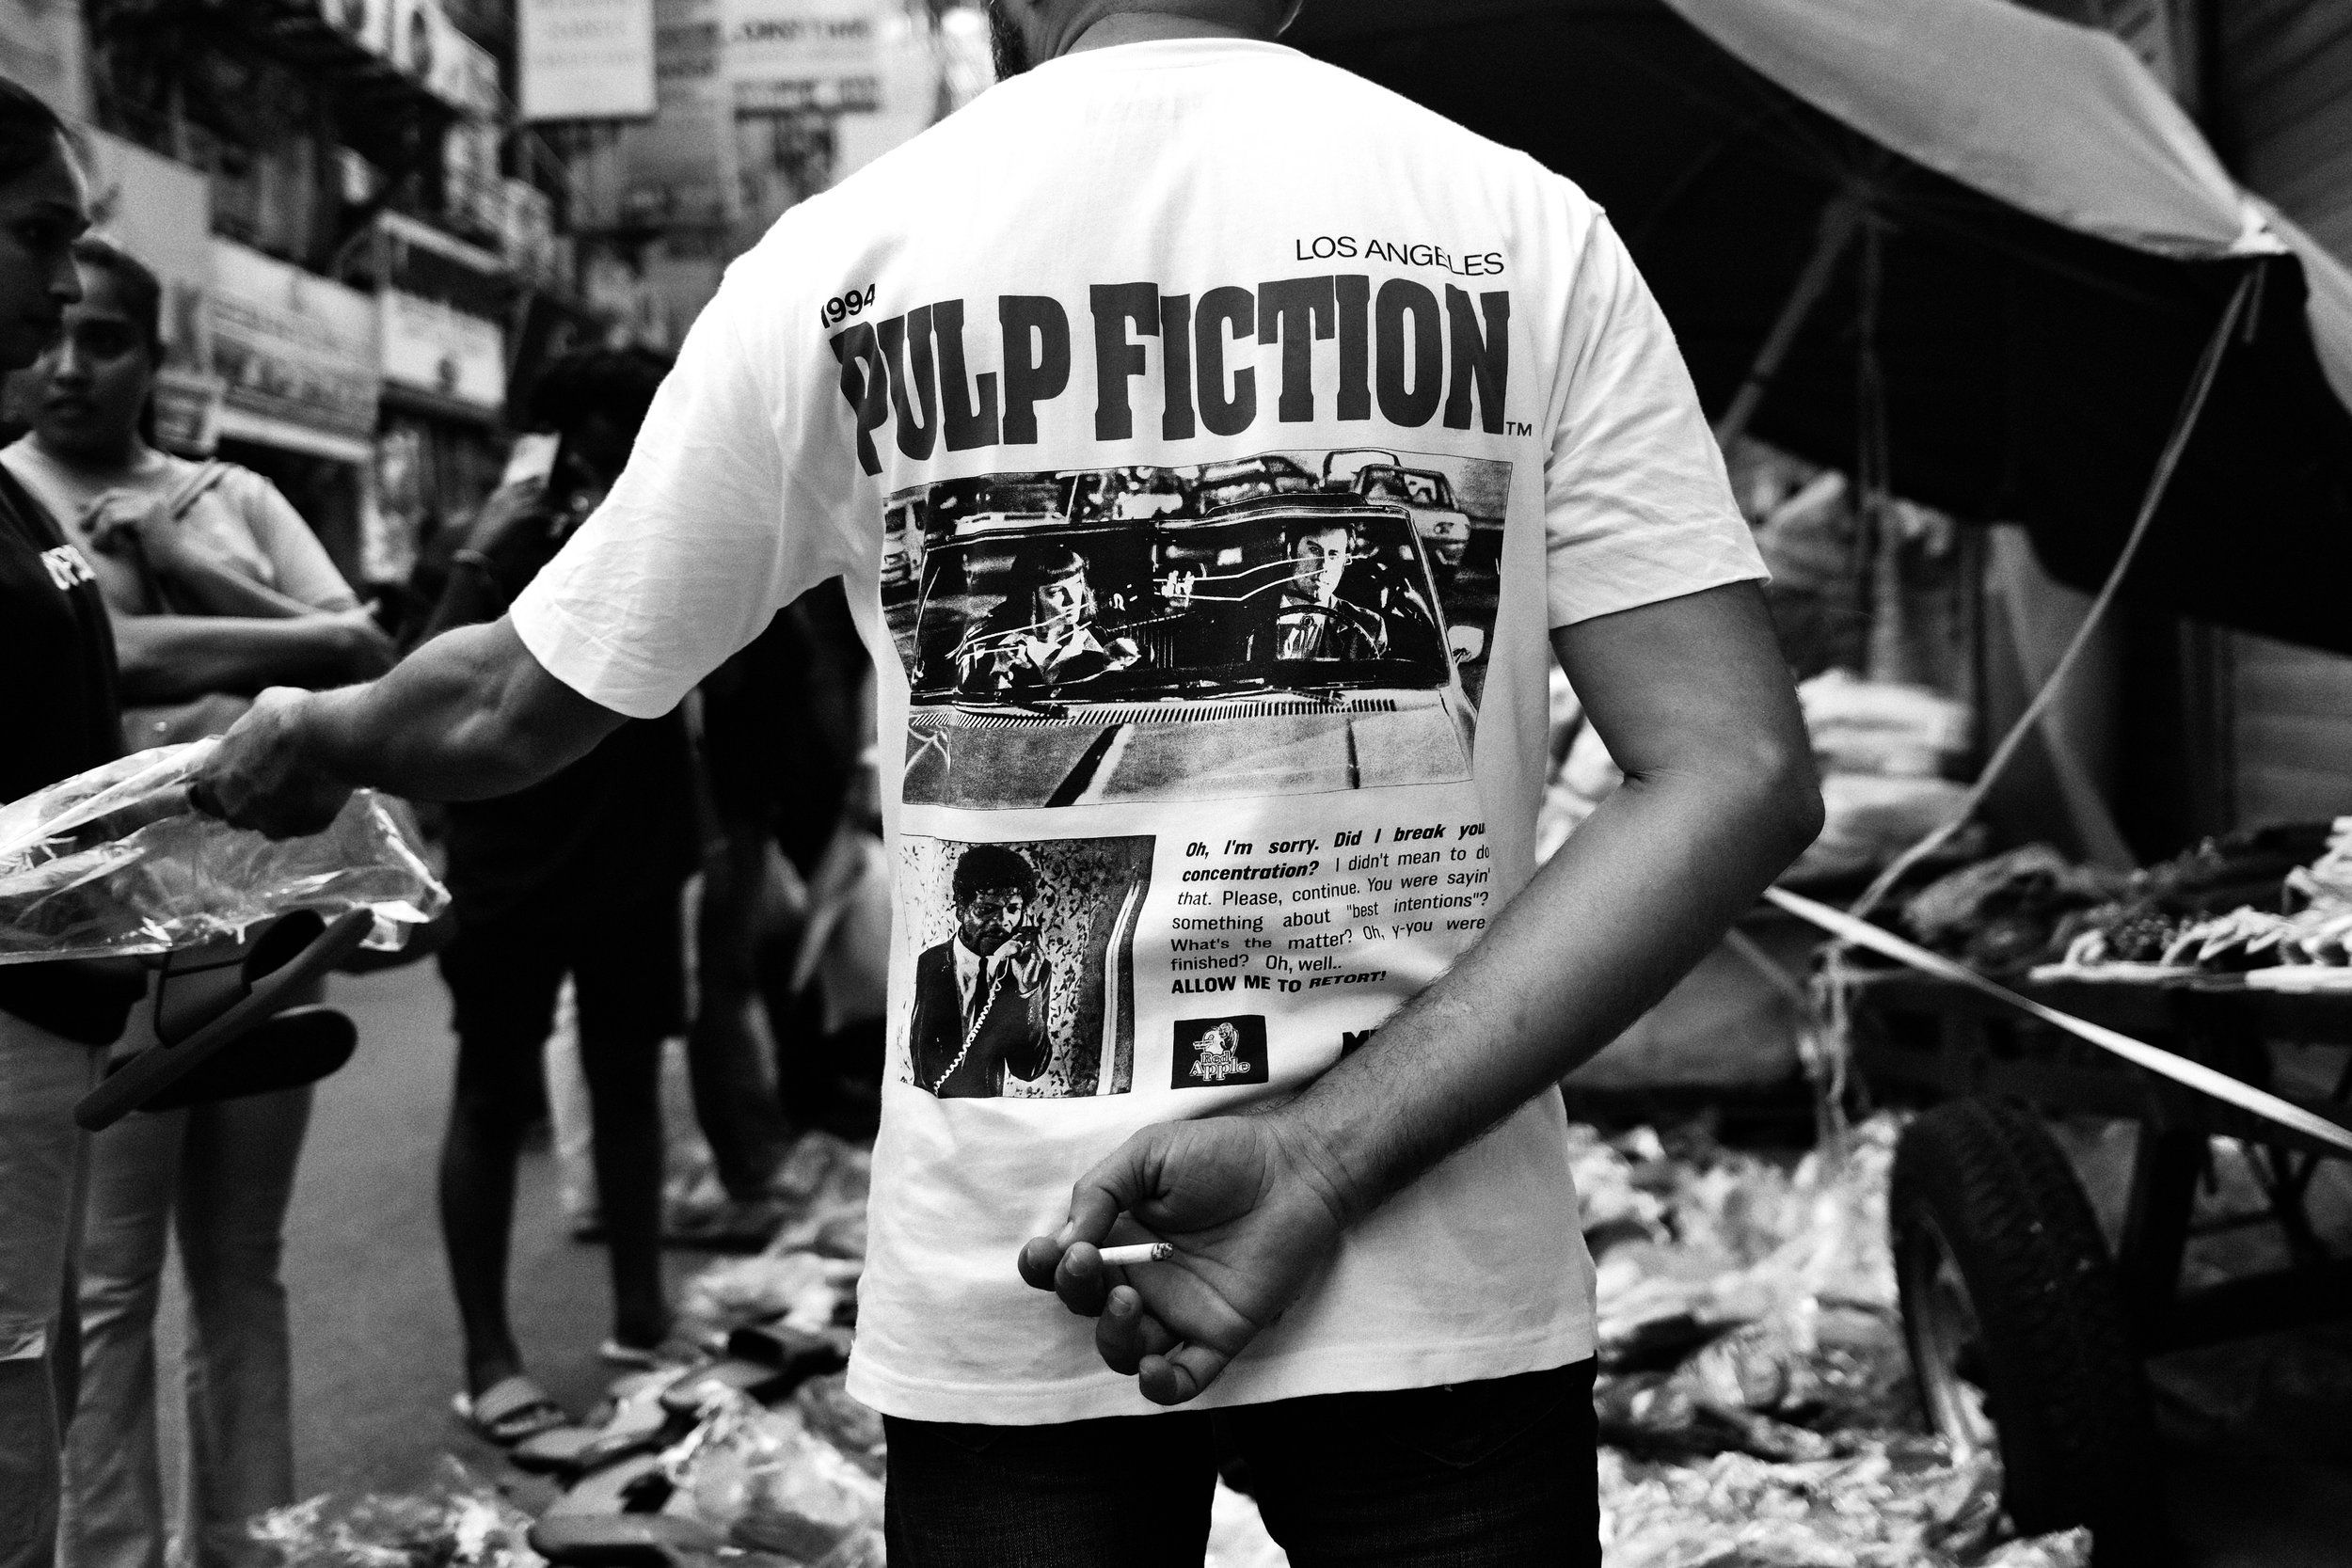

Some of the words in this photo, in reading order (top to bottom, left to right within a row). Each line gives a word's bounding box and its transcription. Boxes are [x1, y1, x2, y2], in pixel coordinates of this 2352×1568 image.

[1295, 236, 1358, 261] LOS
[1364, 239, 1504, 275] ANGELES
[819, 283, 877, 329] 1994
[828, 294, 1071, 476] PULP
[1089, 275, 1511, 440] FICTION
[1185, 841, 1209, 860] Oh,
[1223, 840, 1253, 855] I'm
[1268, 839, 1319, 855] sorry.
[1334, 830, 1362, 847] Did
[1375, 828, 1382, 844] I
[1393, 824, 1447, 842] break
[1458, 822, 1486, 841] you
[1182, 861, 1320, 882] concentration?
[1335, 857, 1340, 872] I
[1348, 853, 1390, 871] didn't
[1397, 851, 1440, 866] mean
[1450, 847, 1467, 862] to
[1476, 844, 1490, 860] do
[1177, 892, 1212, 906] that.
[1222, 890, 1282, 907] Please,
[1292, 882, 1360, 902] continue.
[1367, 877, 1392, 893] You
[1401, 875, 1438, 889] were
[1447, 867, 1491, 888] sayin'
[1170, 938, 1230, 952] What's
[1245, 937, 1272, 949] the
[1288, 928, 1352, 950] matter?
[1362, 926, 1386, 941] Oh,
[1392, 920, 1433, 940] y-you
[1446, 918, 1486, 930] were
[1282, 909, 1331, 928] about
[1170, 954, 1249, 972] finished?
[1265, 955, 1293, 974] Oh,
[1171, 975, 1237, 994] ALLOW
[1244, 974, 1271, 990] ME
[1278, 978, 1302, 993] TO
[1309, 970, 1387, 989] RETORT!
[1189, 1057, 1251, 1081] Apple
[1200, 1051, 1231, 1065] Red
